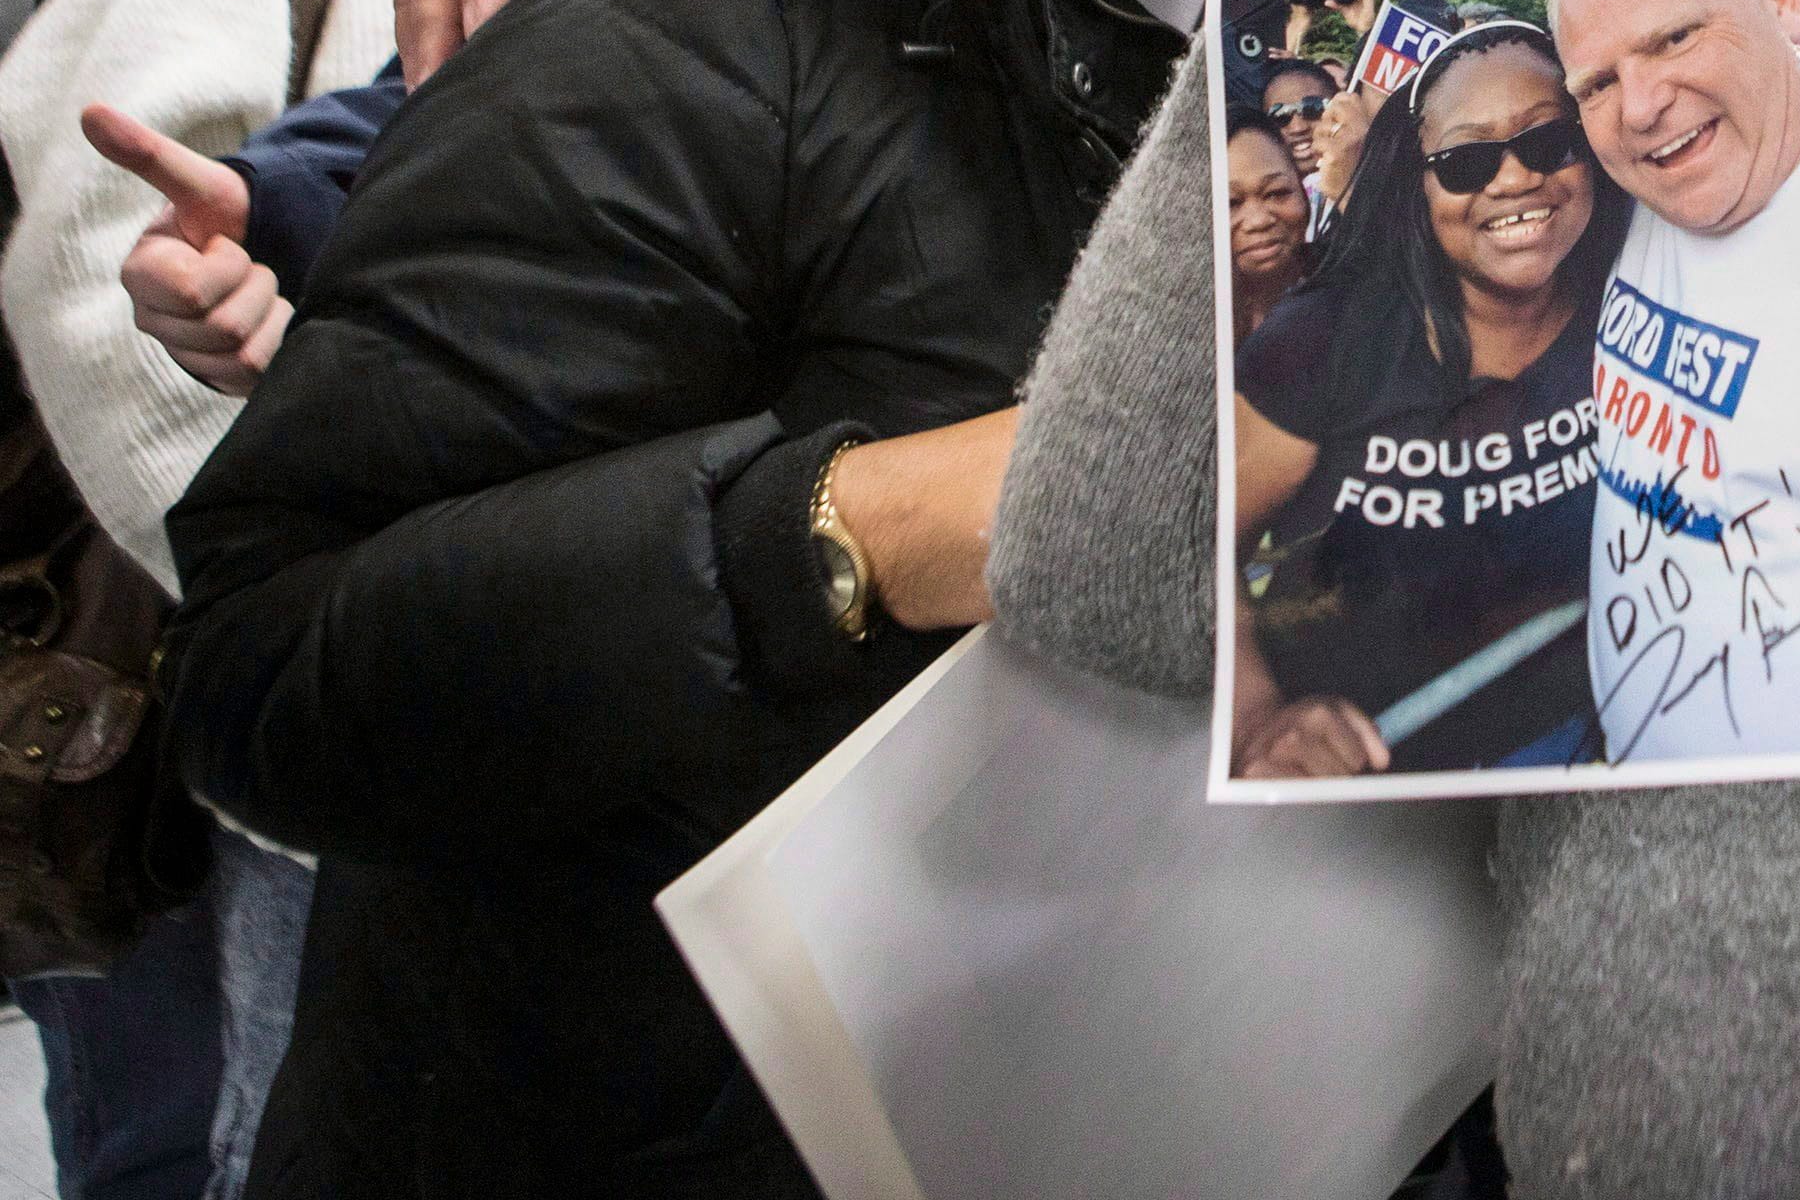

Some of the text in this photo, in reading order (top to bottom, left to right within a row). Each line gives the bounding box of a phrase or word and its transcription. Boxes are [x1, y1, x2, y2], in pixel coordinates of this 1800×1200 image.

[1373, 50, 1416, 91] N
[1365, 397, 1599, 478] DOUG FOR
[1334, 442, 1600, 529] FOR PREM
[1606, 558, 1692, 652] DID
